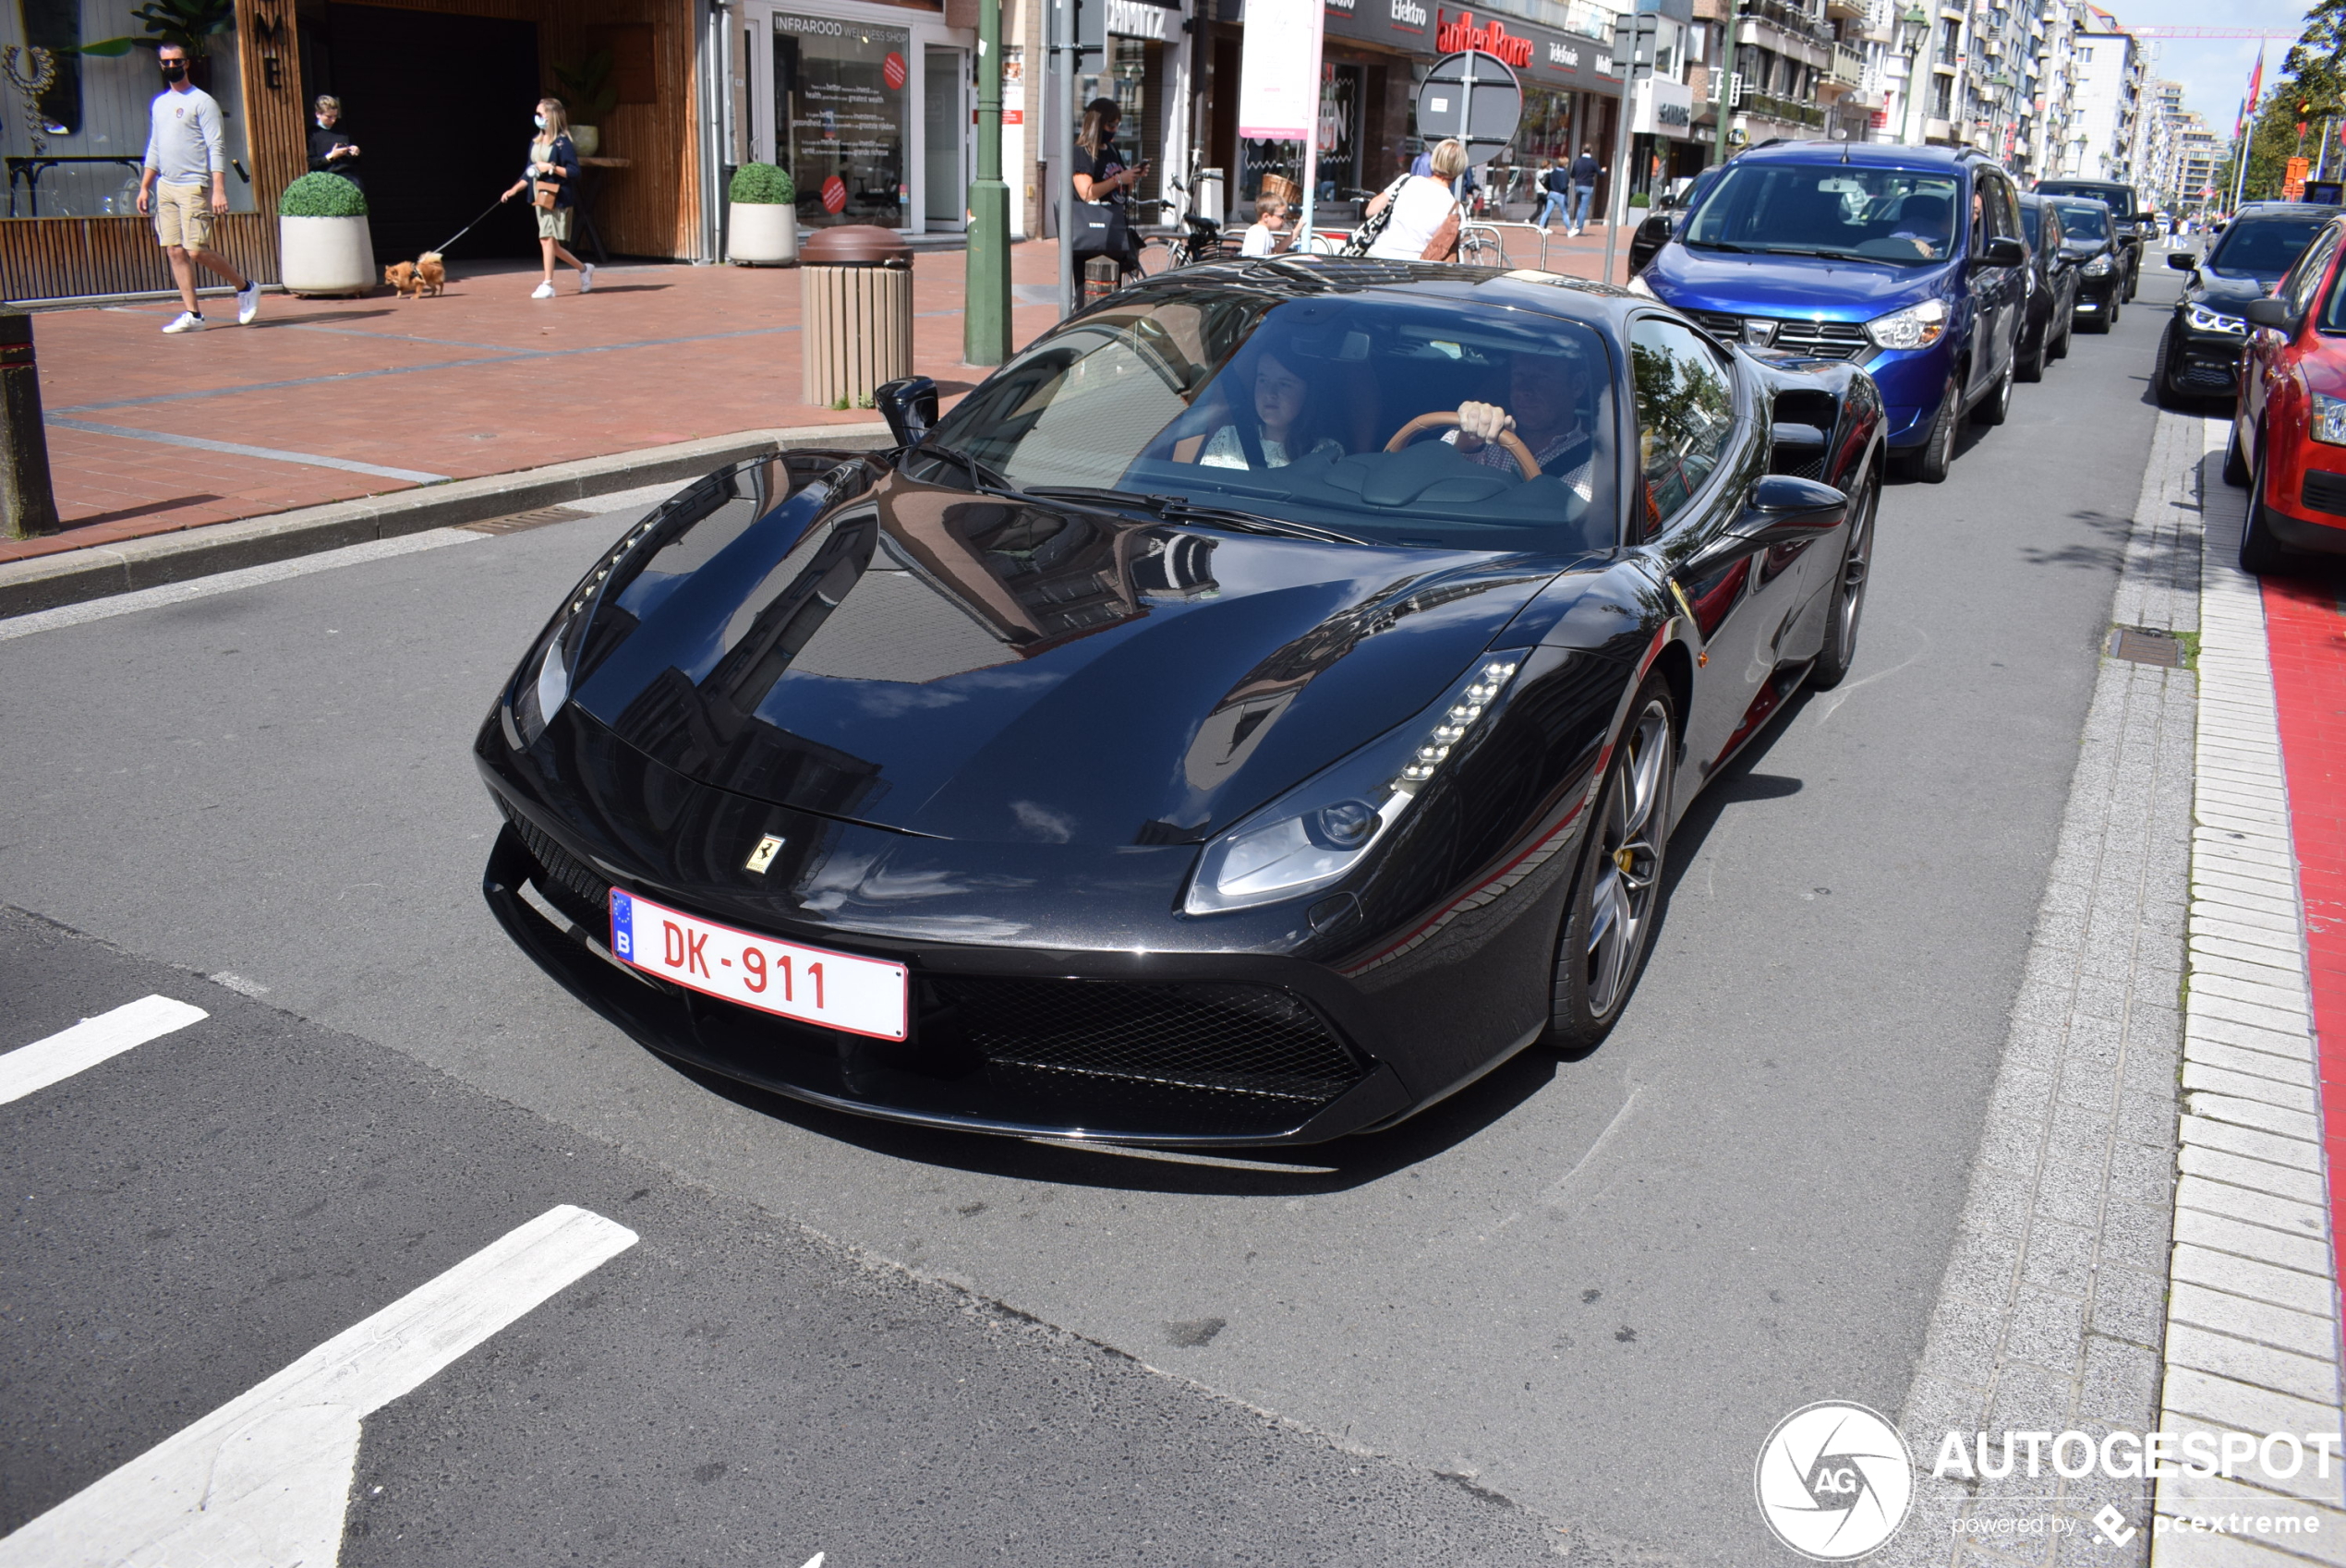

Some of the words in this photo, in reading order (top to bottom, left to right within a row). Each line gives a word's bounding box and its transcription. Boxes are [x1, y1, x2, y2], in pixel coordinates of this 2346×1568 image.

[775, 16, 842, 36] INFRAROOD
[843, 26, 885, 41] WELLNESS
[886, 31, 908, 43] SHOP
[1391, 0, 1426, 26] Elektro
[255, 0, 283, 89] ME
[1486, 20, 1534, 68] Borre
[1550, 42, 1578, 66] Telefonie
[2004, 122, 2017, 161] HEMA
[617, 931, 630, 954] B
[663, 920, 825, 1009] DK-911
